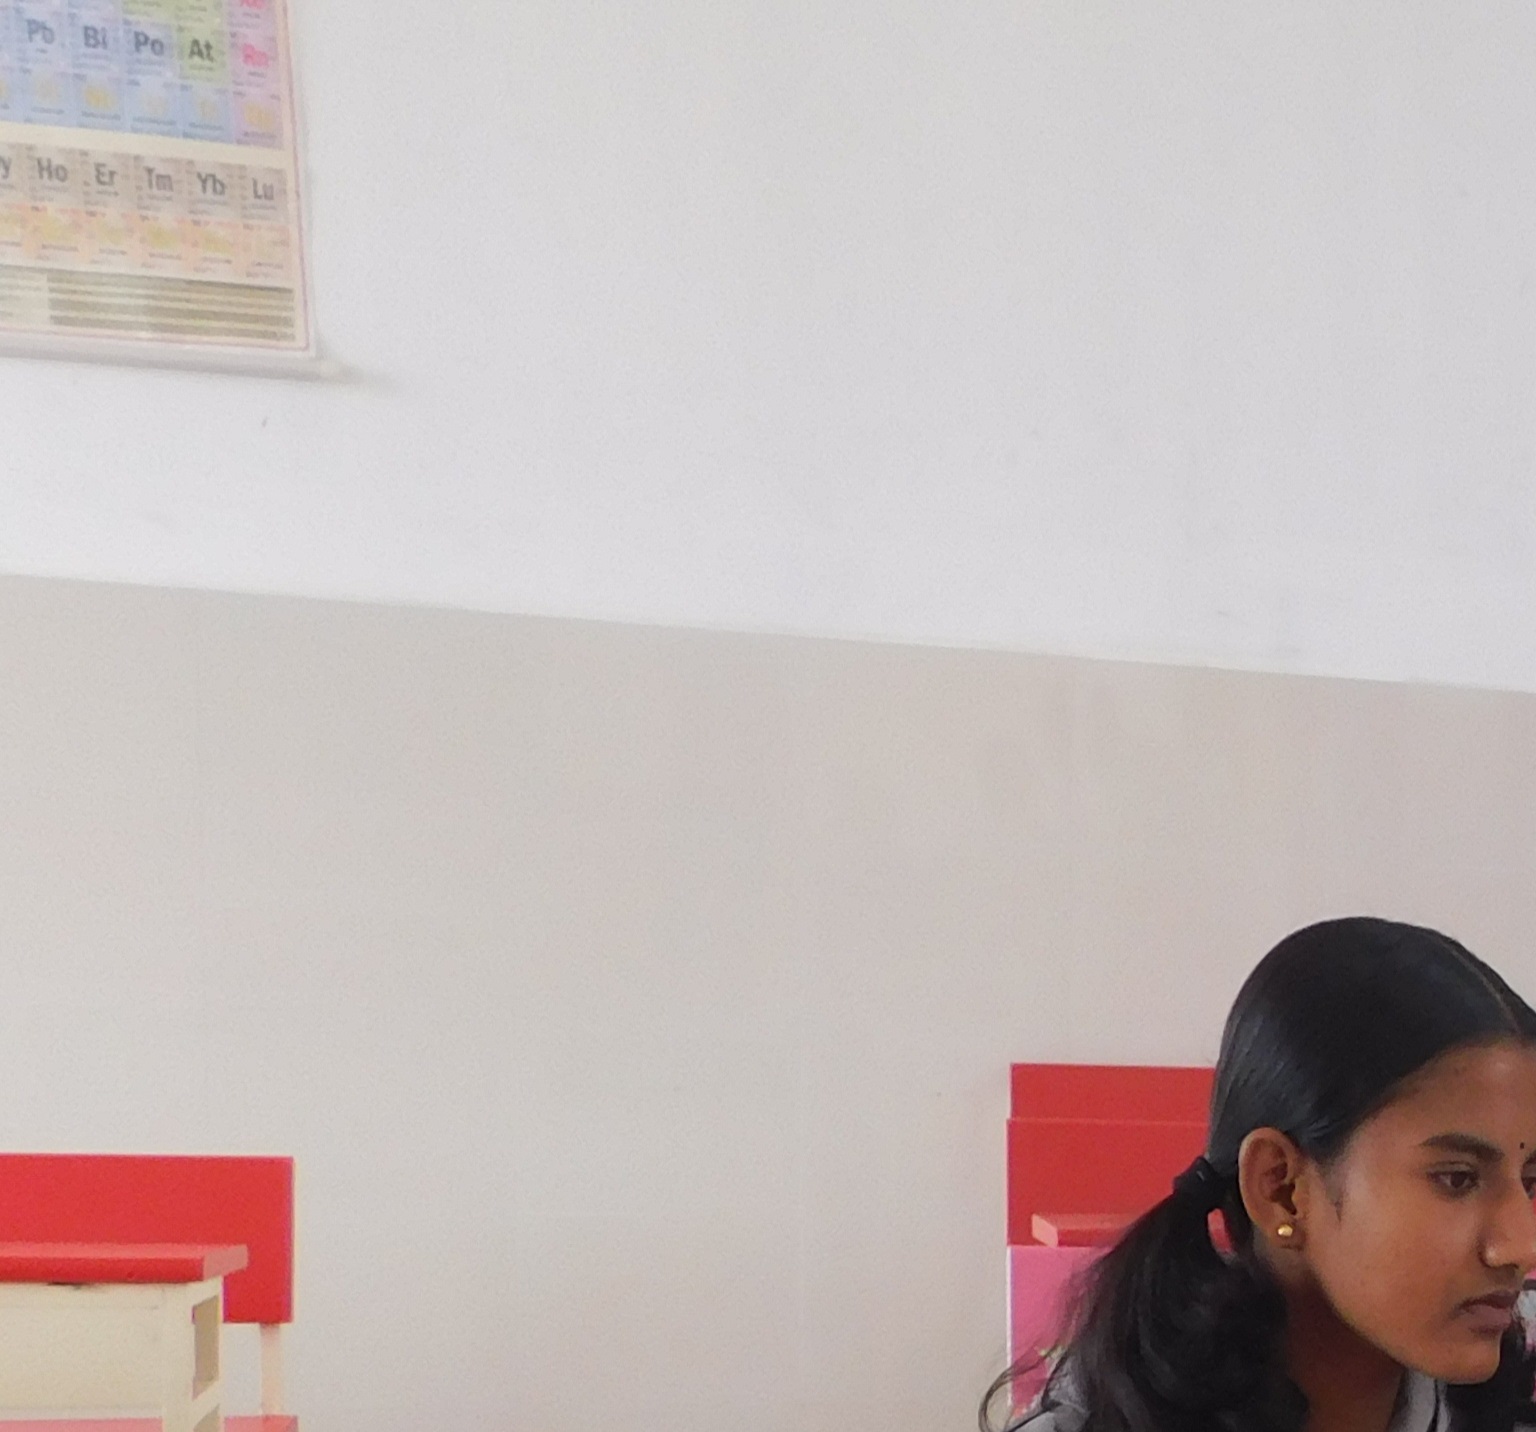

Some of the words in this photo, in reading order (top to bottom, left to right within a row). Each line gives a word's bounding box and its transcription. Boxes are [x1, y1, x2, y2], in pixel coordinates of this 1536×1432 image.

[83, 26, 108, 49] Bi
[134, 31, 164, 57] Po
[188, 39, 215, 62] At
[37, 157, 68, 183] Ho
[94, 162, 117, 187] Er
[144, 167, 174, 192] Tm
[197, 171, 226, 197] Yb
[252, 177, 275, 201] Lu
